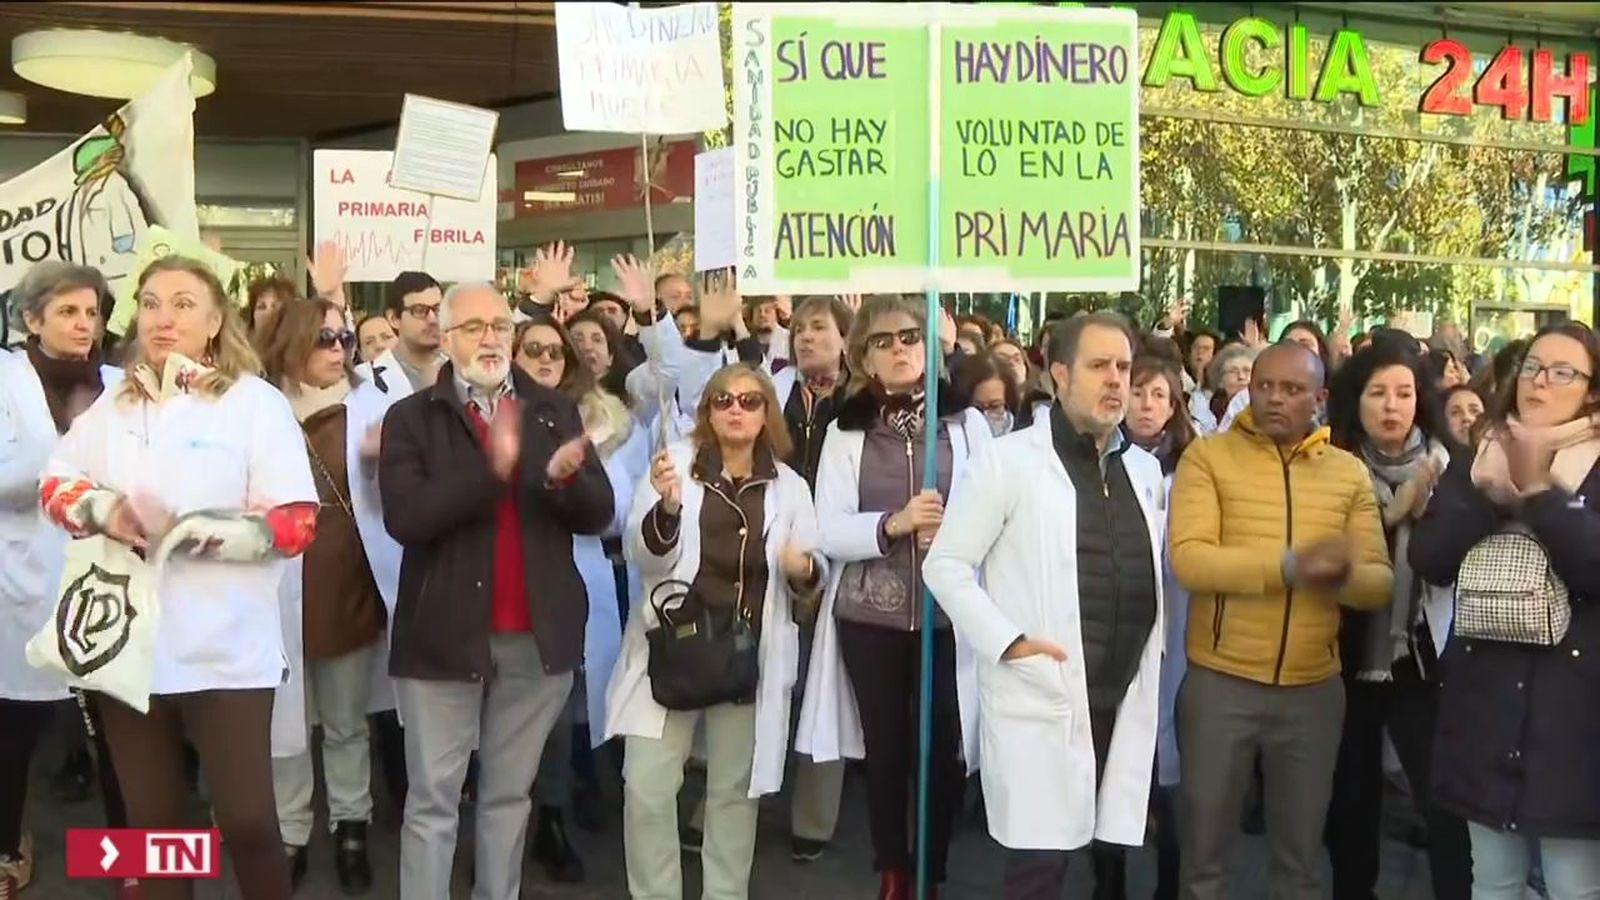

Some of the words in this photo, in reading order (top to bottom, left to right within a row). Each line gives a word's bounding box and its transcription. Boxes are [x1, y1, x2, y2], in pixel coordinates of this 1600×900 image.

[777, 31, 807, 82] SÍ
[821, 41, 886, 80] QUE
[955, 40, 1011, 84] HAY
[1143, 12, 1381, 107] ACIA
[1420, 38, 1589, 126] 24H
[774, 118, 814, 143] NO
[831, 117, 886, 144] HAY
[956, 119, 1085, 146] VOLUNTAD
[1096, 121, 1124, 146] DE
[331, 169, 354, 183] LA
[776, 147, 887, 178] GASTAR
[963, 147, 996, 176] LO
[1020, 150, 1063, 178] EN
[1077, 150, 1113, 180] LA
[338, 202, 430, 217] PRIMARIA
[414, 229, 485, 244] FBRILA
[774, 203, 896, 260] ATENCIÓN
